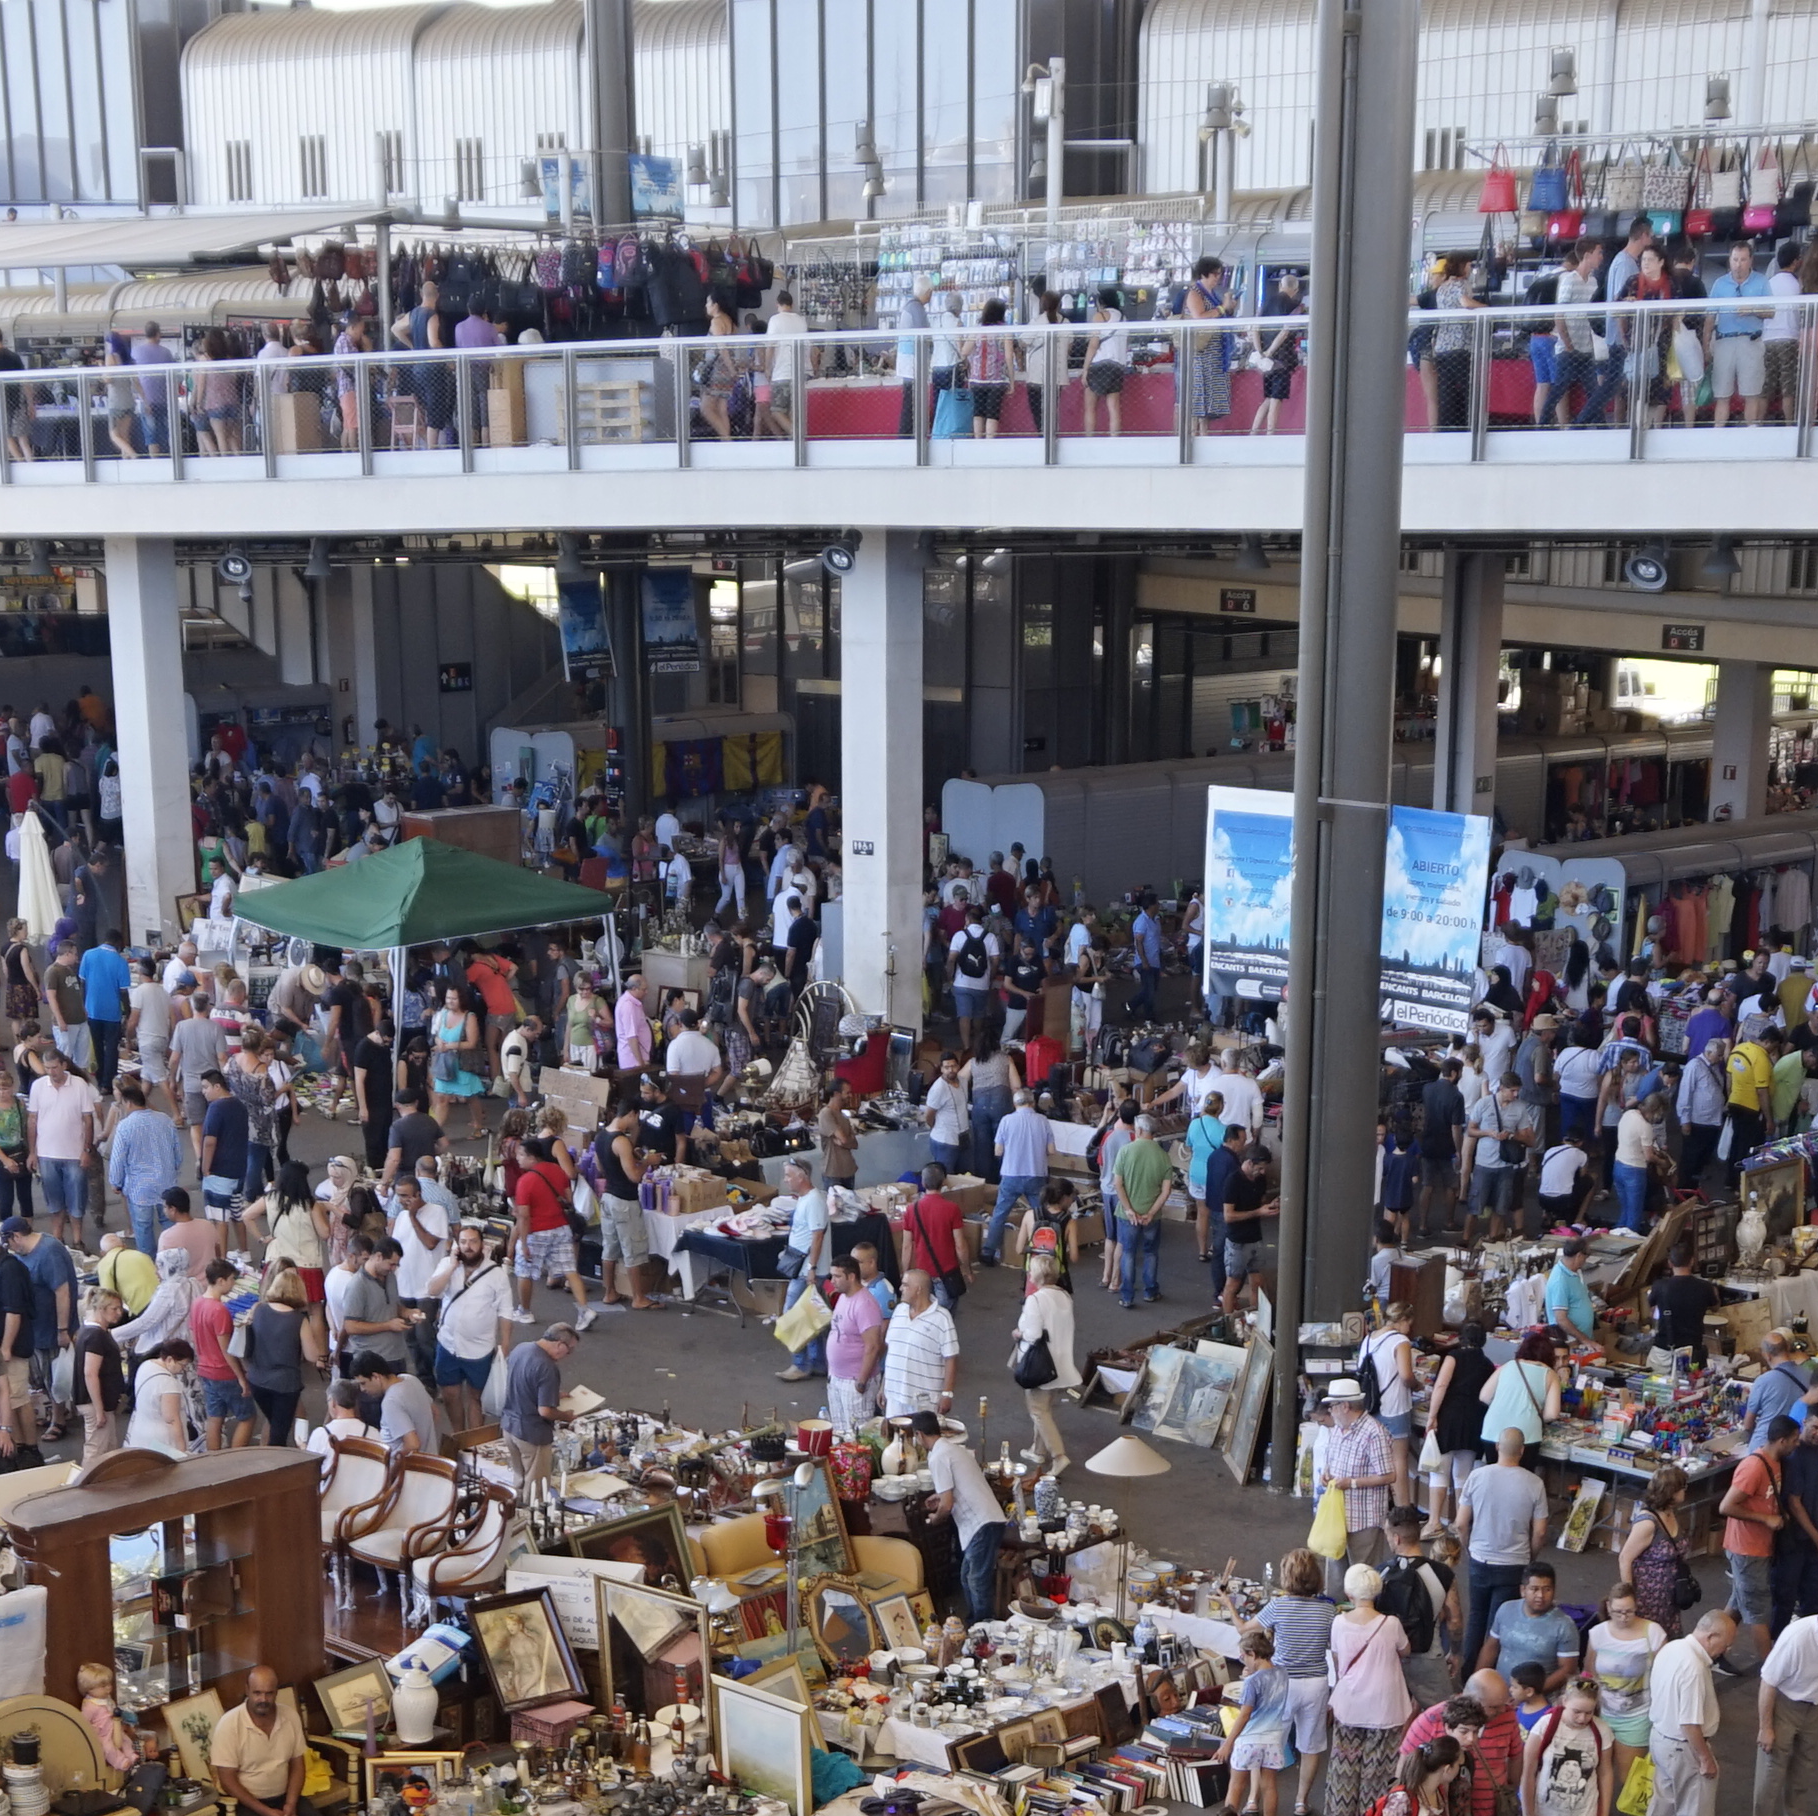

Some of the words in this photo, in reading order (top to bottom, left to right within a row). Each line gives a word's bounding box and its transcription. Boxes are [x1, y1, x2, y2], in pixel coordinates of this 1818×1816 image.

[1243, 601, 1250, 610] 6
[1689, 638, 1697, 649] 5
[1412, 860, 1460, 876] ABIERTO
[1386, 906, 1398, 918] de
[1401, 908, 1423, 922] 9:00
[1426, 914, 1433, 922] a
[1435, 913, 1468, 929] 20:00
[1211, 961, 1245, 973] ENCANTS
[1248, 965, 1289, 978] BARCELON
[1380, 981, 1419, 996] ENCANTS
